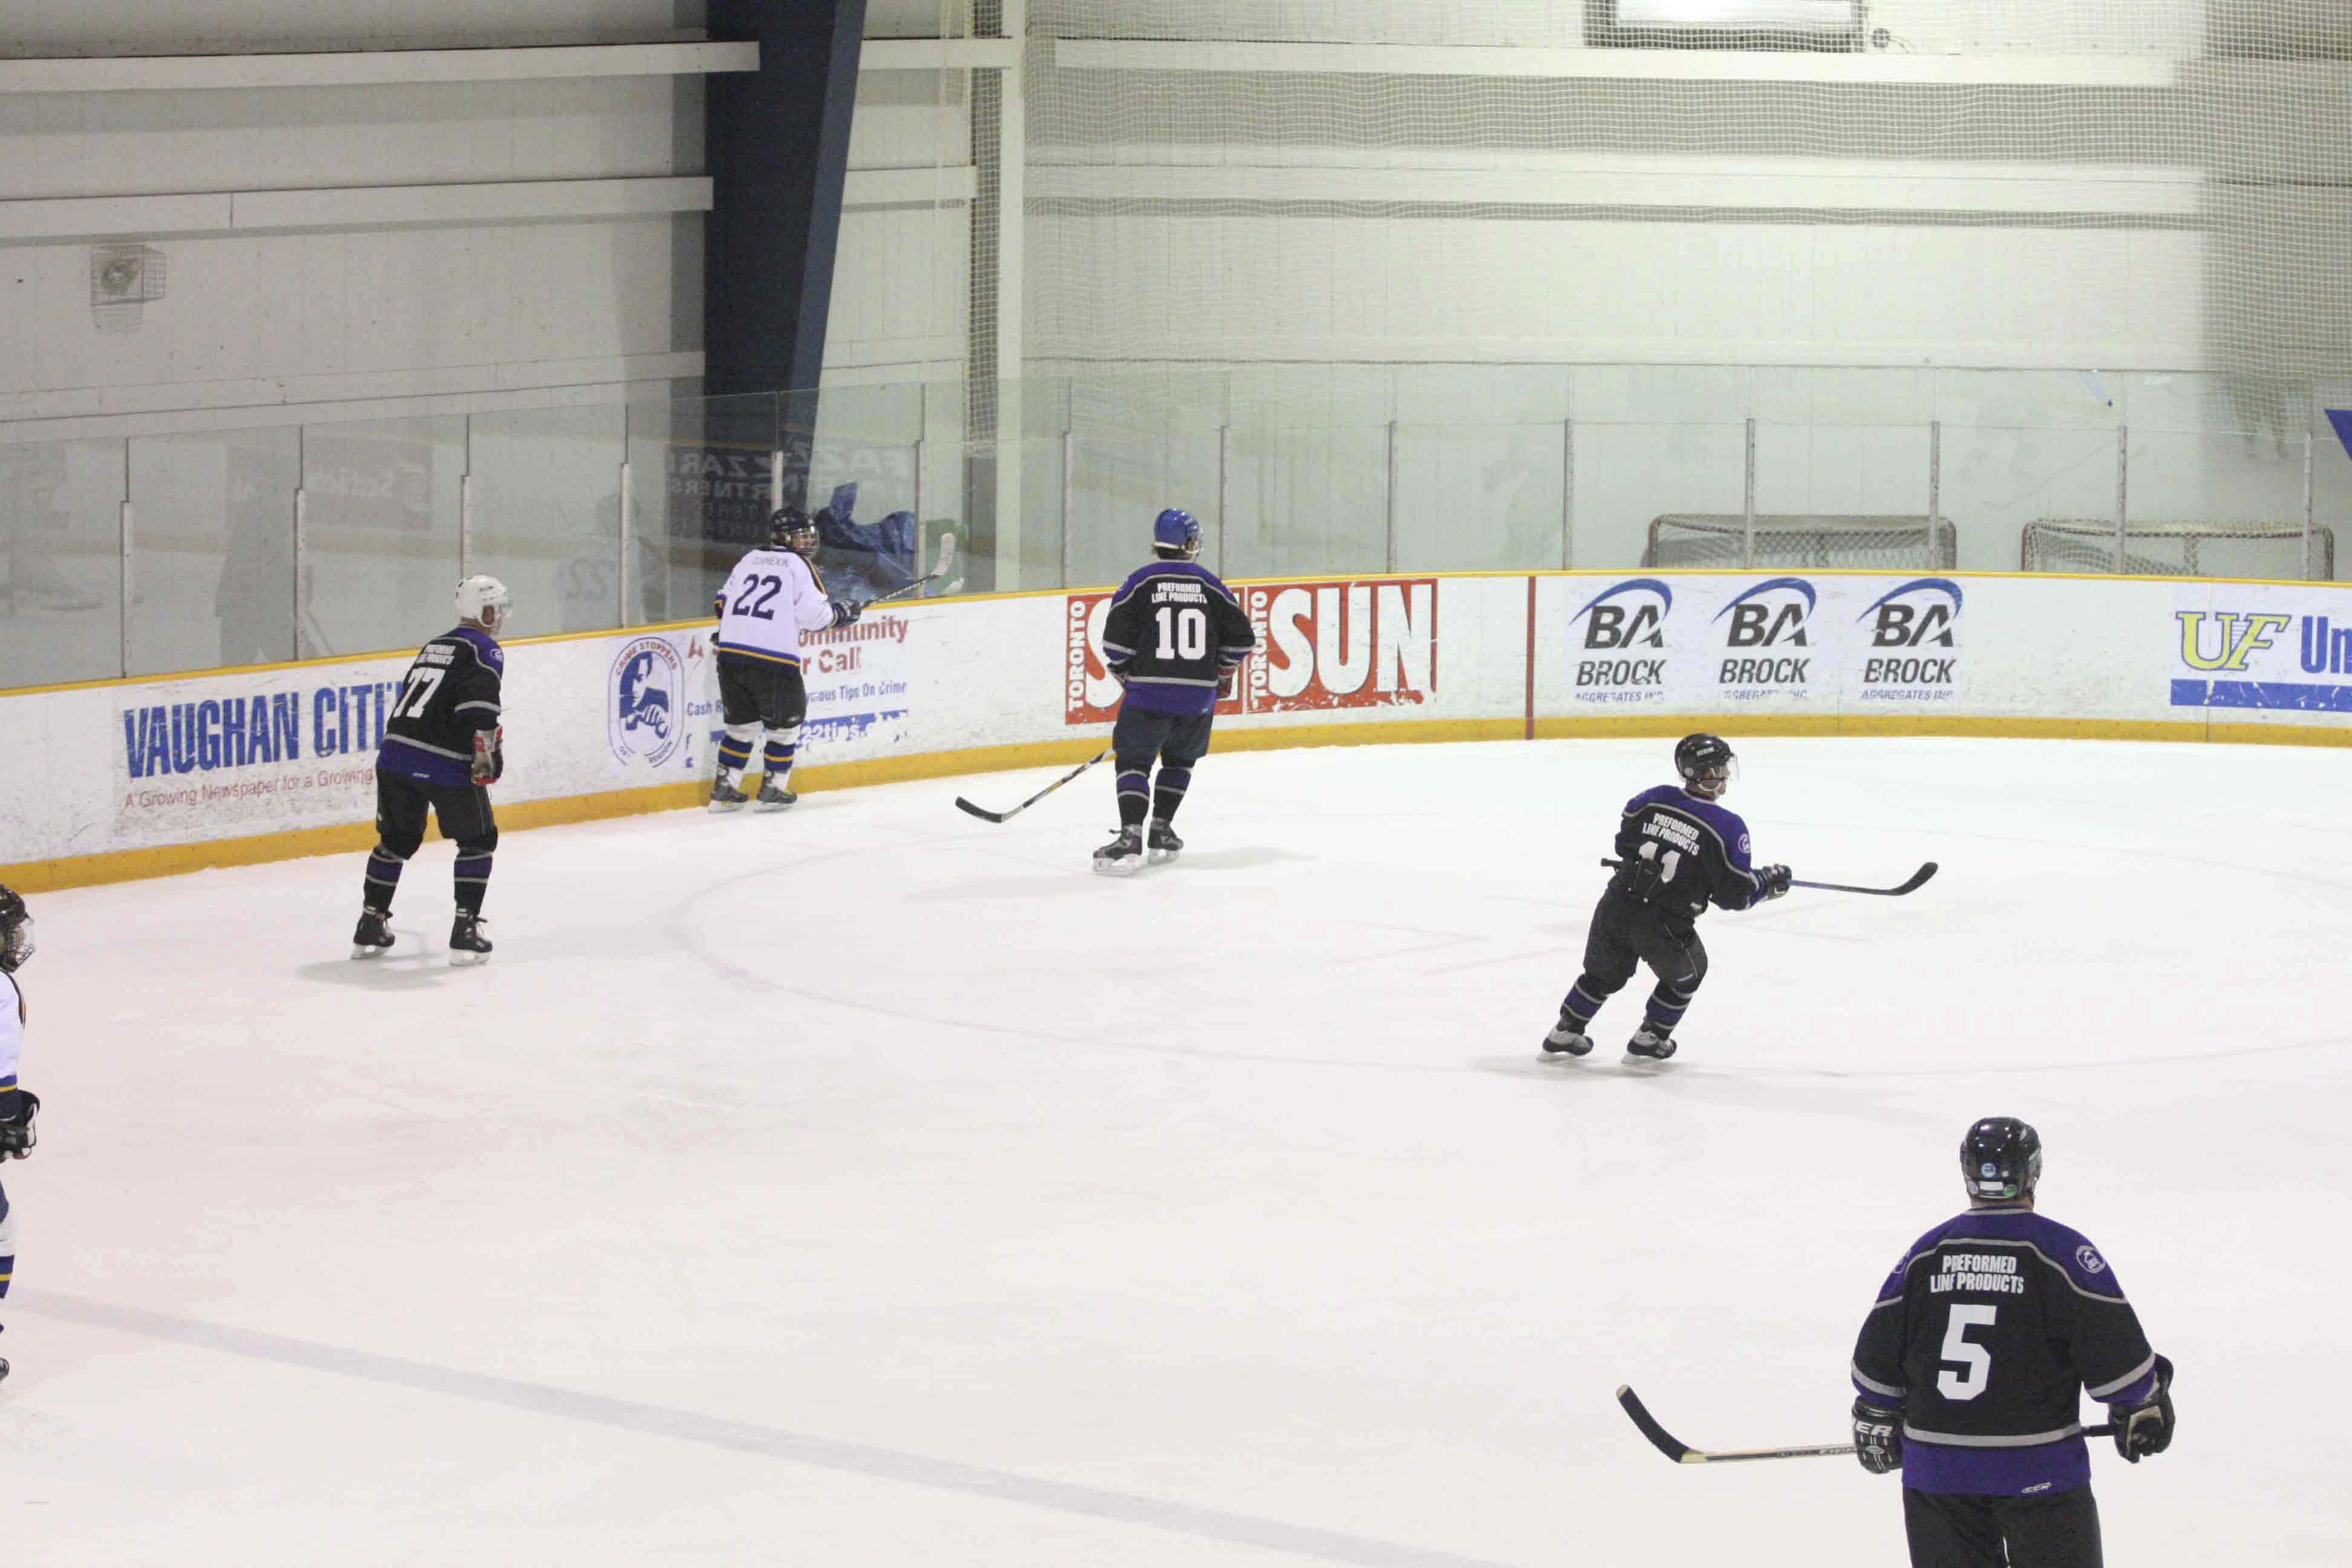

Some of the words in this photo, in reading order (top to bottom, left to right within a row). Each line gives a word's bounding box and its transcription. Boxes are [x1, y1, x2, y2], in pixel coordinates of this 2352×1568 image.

[732, 573, 782, 620] 22
[1157, 582, 1201, 593] PREFORMED
[797, 615, 909, 647] ommunity
[1155, 607, 1206, 660] 10
[1269, 584, 1432, 697] SUN
[2175, 611, 2292, 671] UF
[2300, 615, 2352, 674] Un
[616, 647, 636, 677] CRIME
[638, 641, 678, 670] STOPPERS
[818, 646, 862, 673] Call
[1068, 600, 1086, 711] TORONTO
[1250, 590, 1269, 709] TORONTO
[1576, 658, 1667, 686] BROCK
[1719, 657, 1811, 684] BROCK
[1863, 657, 1957, 684] BROCK
[840, 684, 860, 701] Tips
[862, 682, 876, 696] On
[687, 700, 712, 716] Cash
[123, 691, 299, 779] VAUGHAN
[313, 680, 404, 758] CITI
[125, 793, 136, 809] A
[140, 789, 198, 807] Growing
[203, 776, 278, 801] Newspaper
[304, 774, 312, 787] a
[318, 768, 373, 787] Growing
[1653, 812, 1700, 843] PREFORMED
[1658, 826, 1700, 857] PRODUCTS
[1942, 1253, 2017, 1274] PREFORMED
[1956, 1272, 2025, 1294] PRODUCTS
[1937, 1303, 1997, 1401] 5
